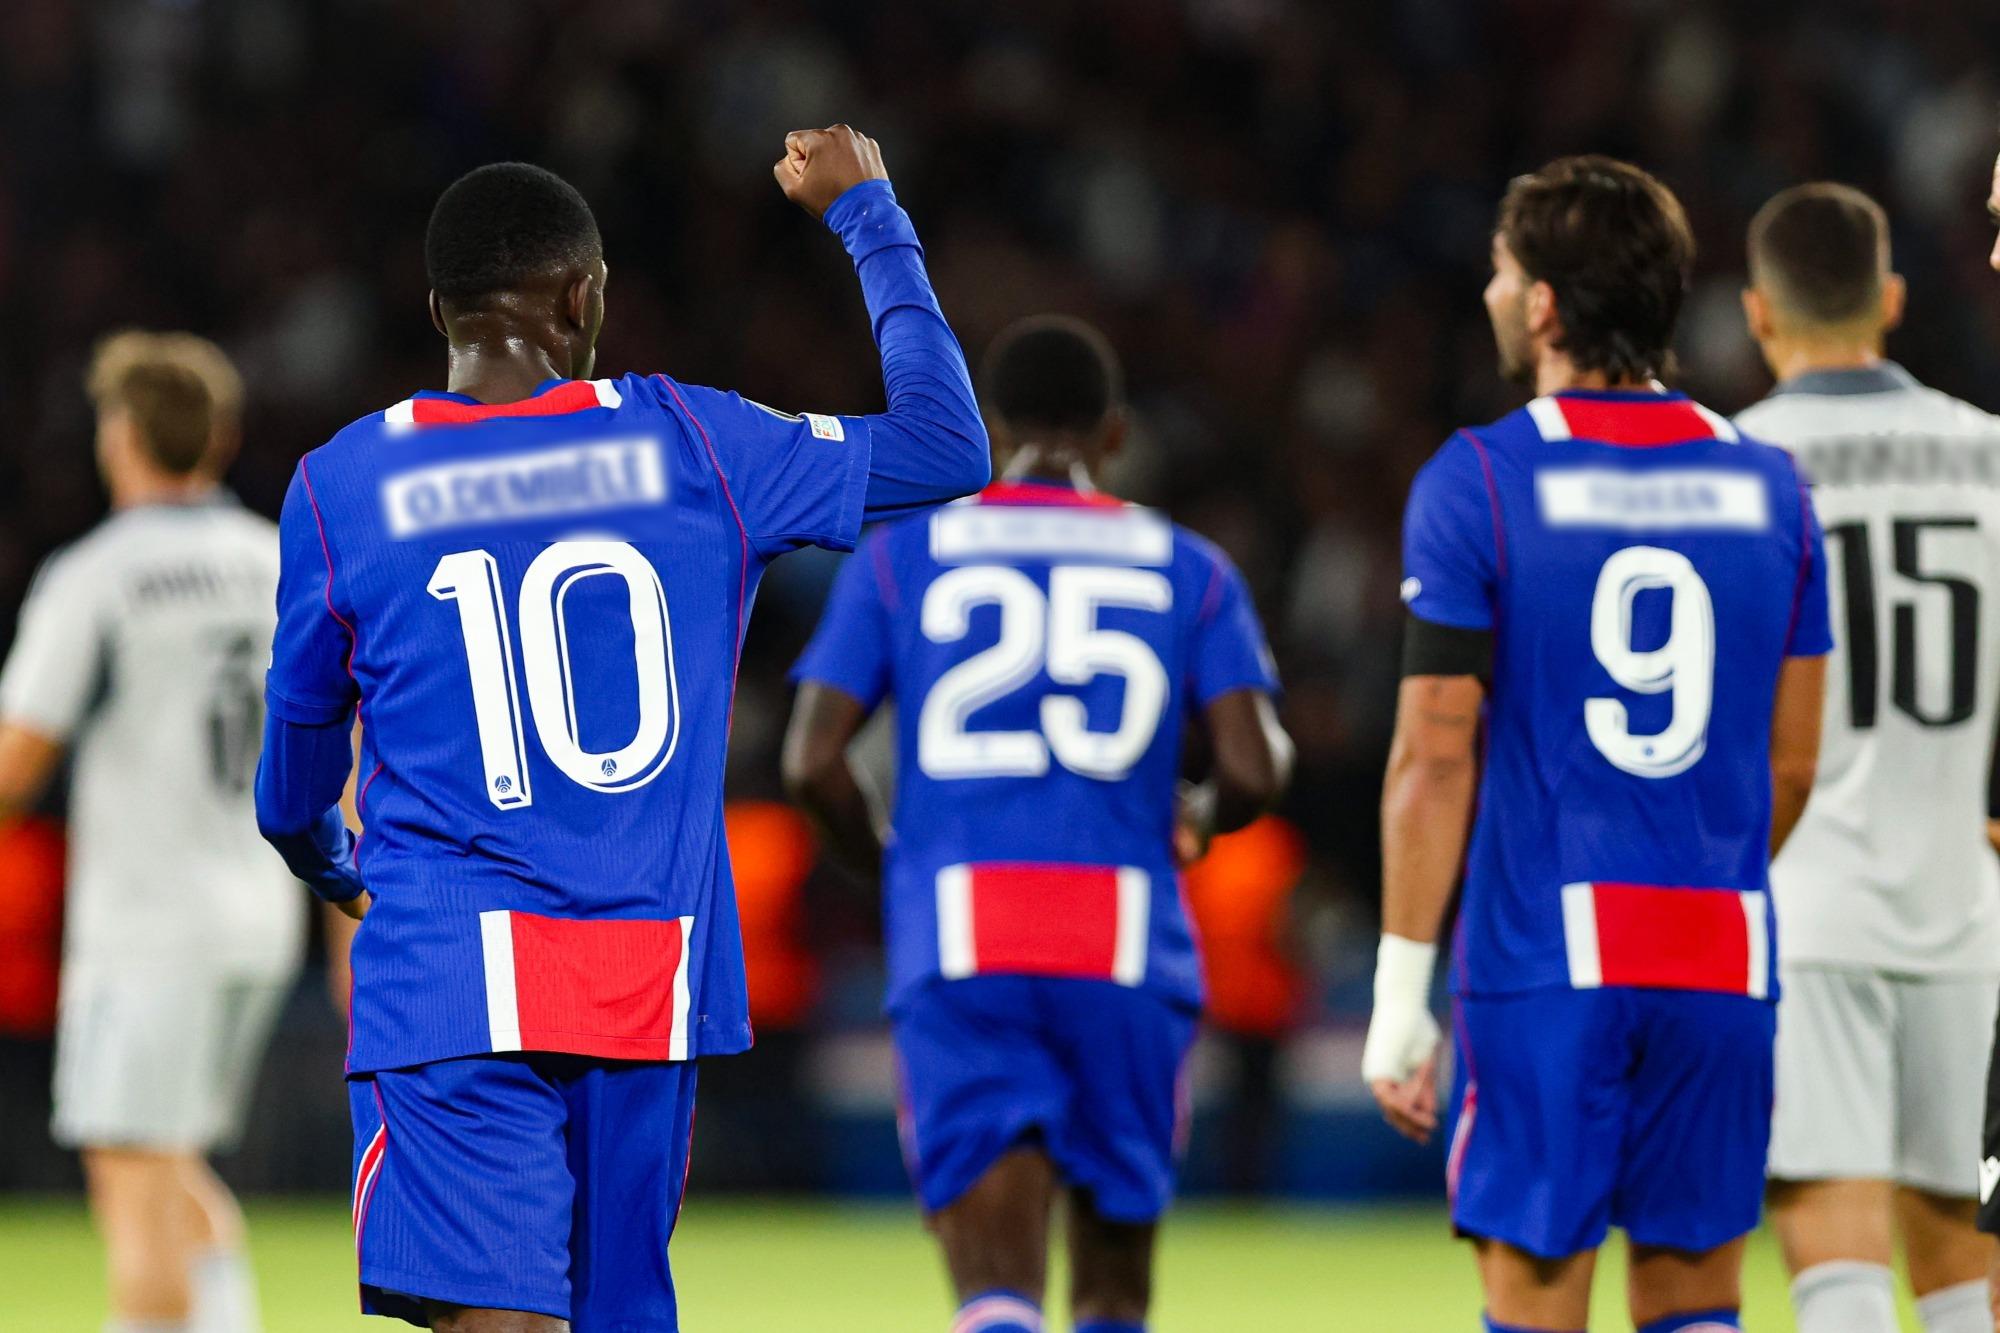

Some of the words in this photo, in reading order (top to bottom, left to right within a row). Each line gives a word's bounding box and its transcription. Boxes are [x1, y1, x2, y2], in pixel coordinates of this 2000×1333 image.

[427, 535, 680, 811] 10
[918, 565, 1173, 780] 25
[1584, 545, 1715, 778] 9
[1825, 516, 1980, 731] 15
